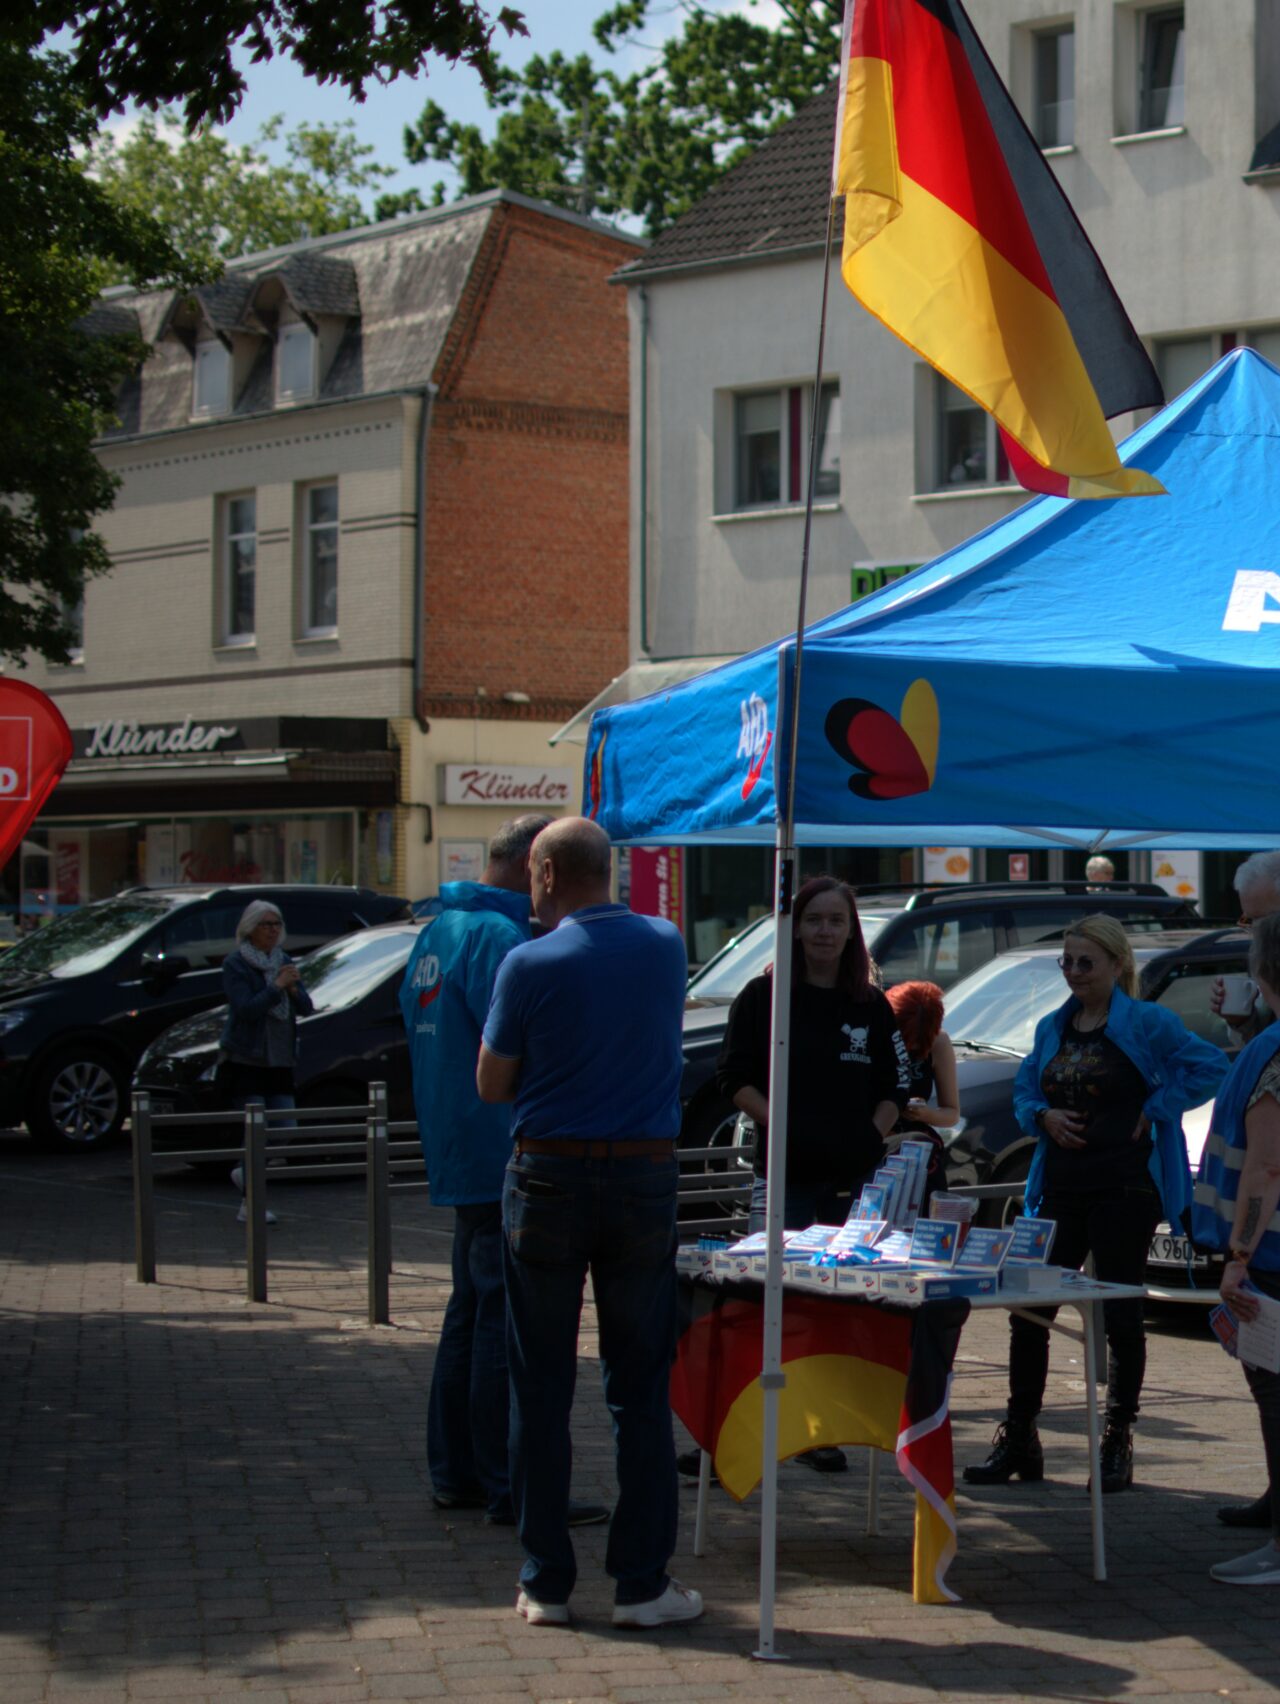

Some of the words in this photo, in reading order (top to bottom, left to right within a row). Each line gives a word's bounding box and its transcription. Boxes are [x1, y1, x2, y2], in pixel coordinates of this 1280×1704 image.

[84, 713, 238, 757] Klünder
[736, 692, 768, 759] AfD
[459, 769, 568, 800] Klünder
